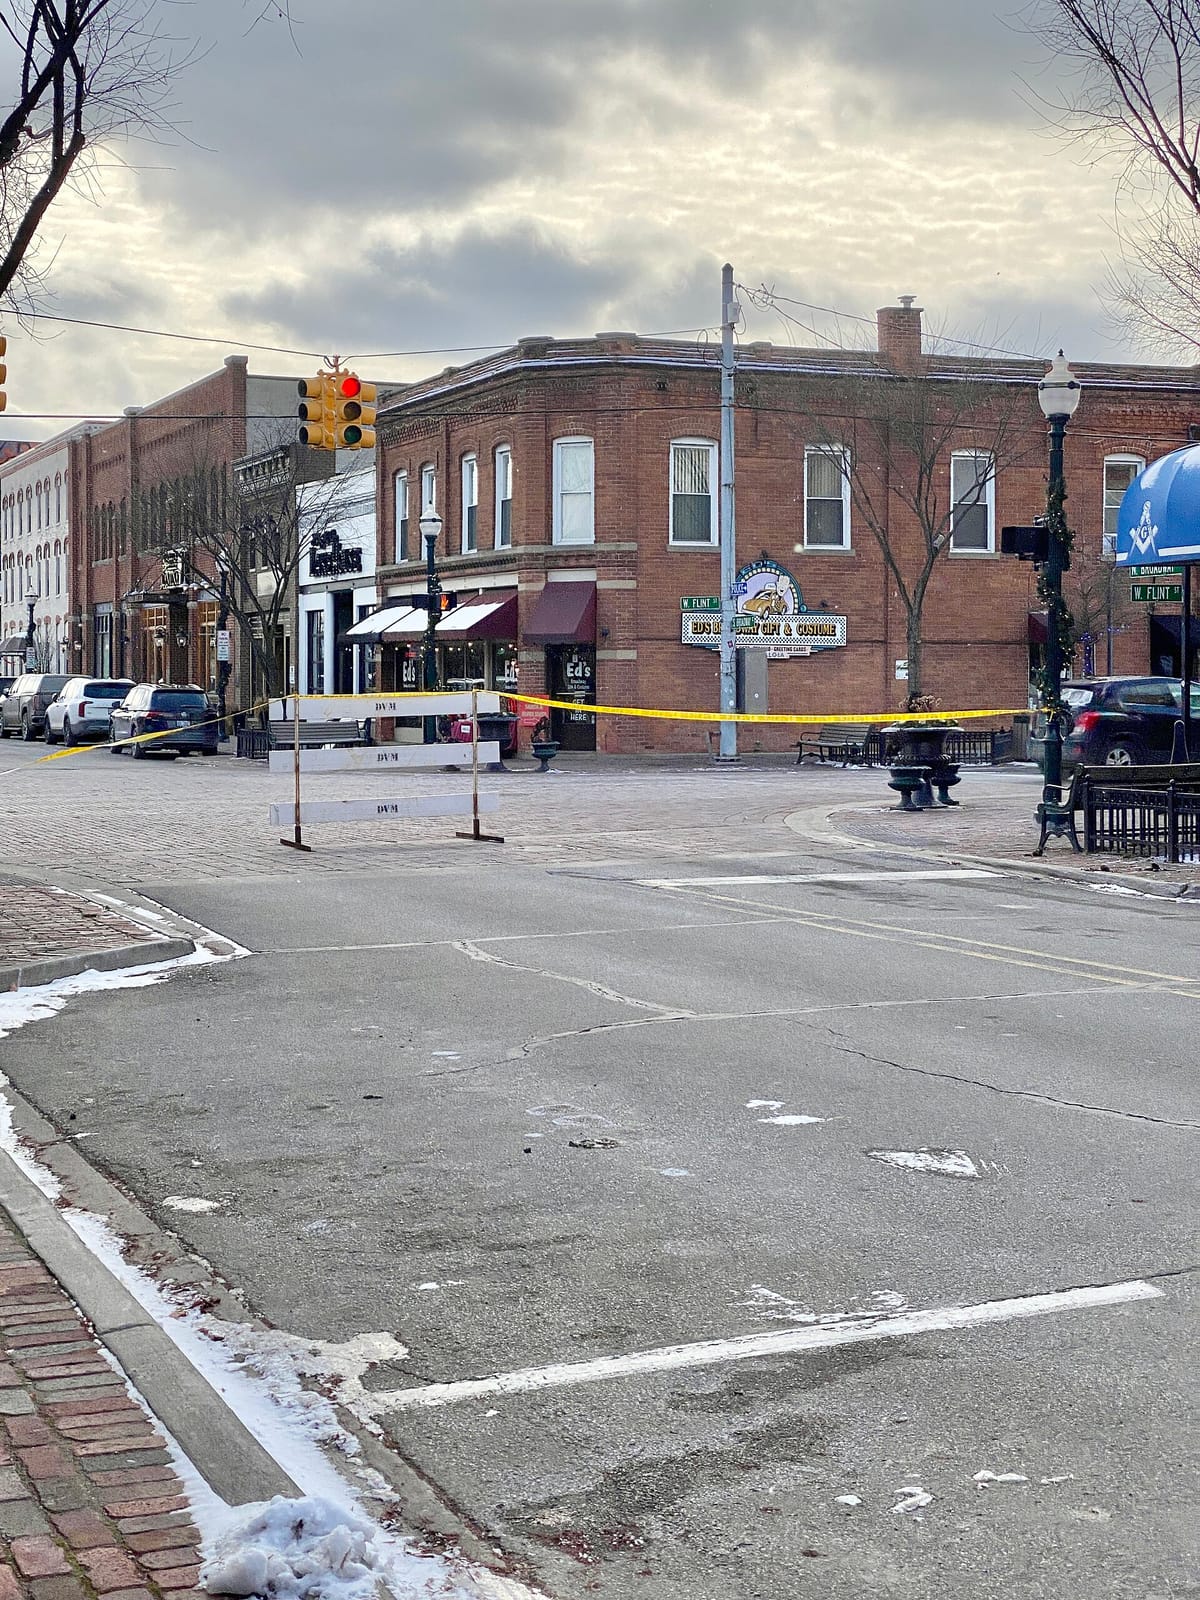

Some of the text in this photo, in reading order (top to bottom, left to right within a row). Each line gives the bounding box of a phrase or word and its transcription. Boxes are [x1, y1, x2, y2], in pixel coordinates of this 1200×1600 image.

[1140, 526, 1147, 538] G
[1133, 586, 1143, 600] W.
[1147, 586, 1170, 600] FLINT
[682, 598, 690, 608] W.
[692, 598, 710, 608] FLINT
[692, 621, 711, 635] ED'S
[761, 622, 781, 636] GIFT
[783, 622, 792, 636] &
[796, 623, 837, 637] COSTUME
[566, 661, 591, 678] Ed's
[375, 702, 396, 711] DVM
[570, 713, 587, 721] HERE
[377, 752, 398, 762] DVM
[377, 804, 398, 814] DVM
